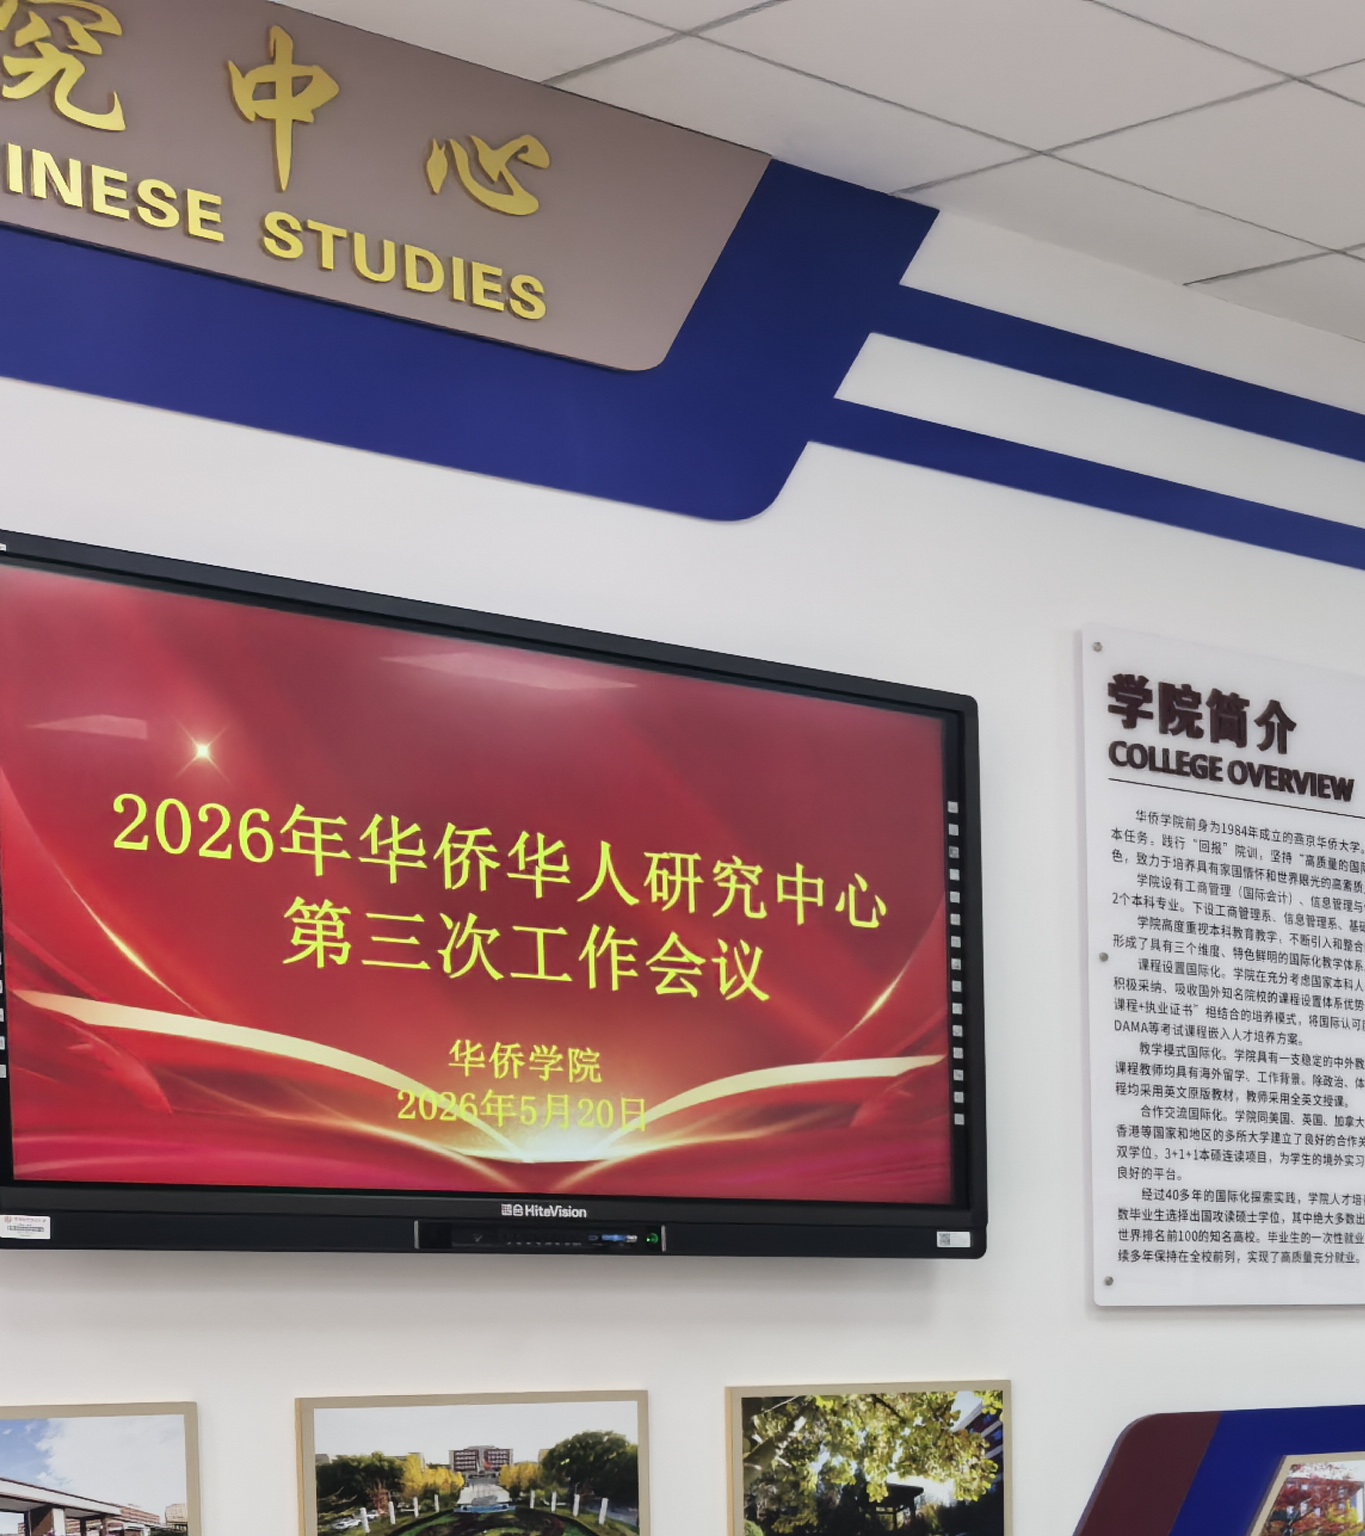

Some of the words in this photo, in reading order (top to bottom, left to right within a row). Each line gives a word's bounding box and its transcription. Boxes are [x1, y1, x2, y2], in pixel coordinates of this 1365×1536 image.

[5, 142, 225, 243] INESE
[262, 210, 547, 321] STUDIES
[1107, 673, 1298, 754] 学院简介
[1108, 741, 1223, 782] COLLEGE
[1227, 760, 1355, 802] OVERVIEW
[111, 792, 889, 930] 2026年华侨华人研究中心
[282, 896, 771, 1003] 第三次工作会议
[447, 1038, 604, 1084] 华侨学院
[396, 1088, 649, 1133] 2026年5月20日
[1116, 1164, 1182, 1182] 良好的平台。
